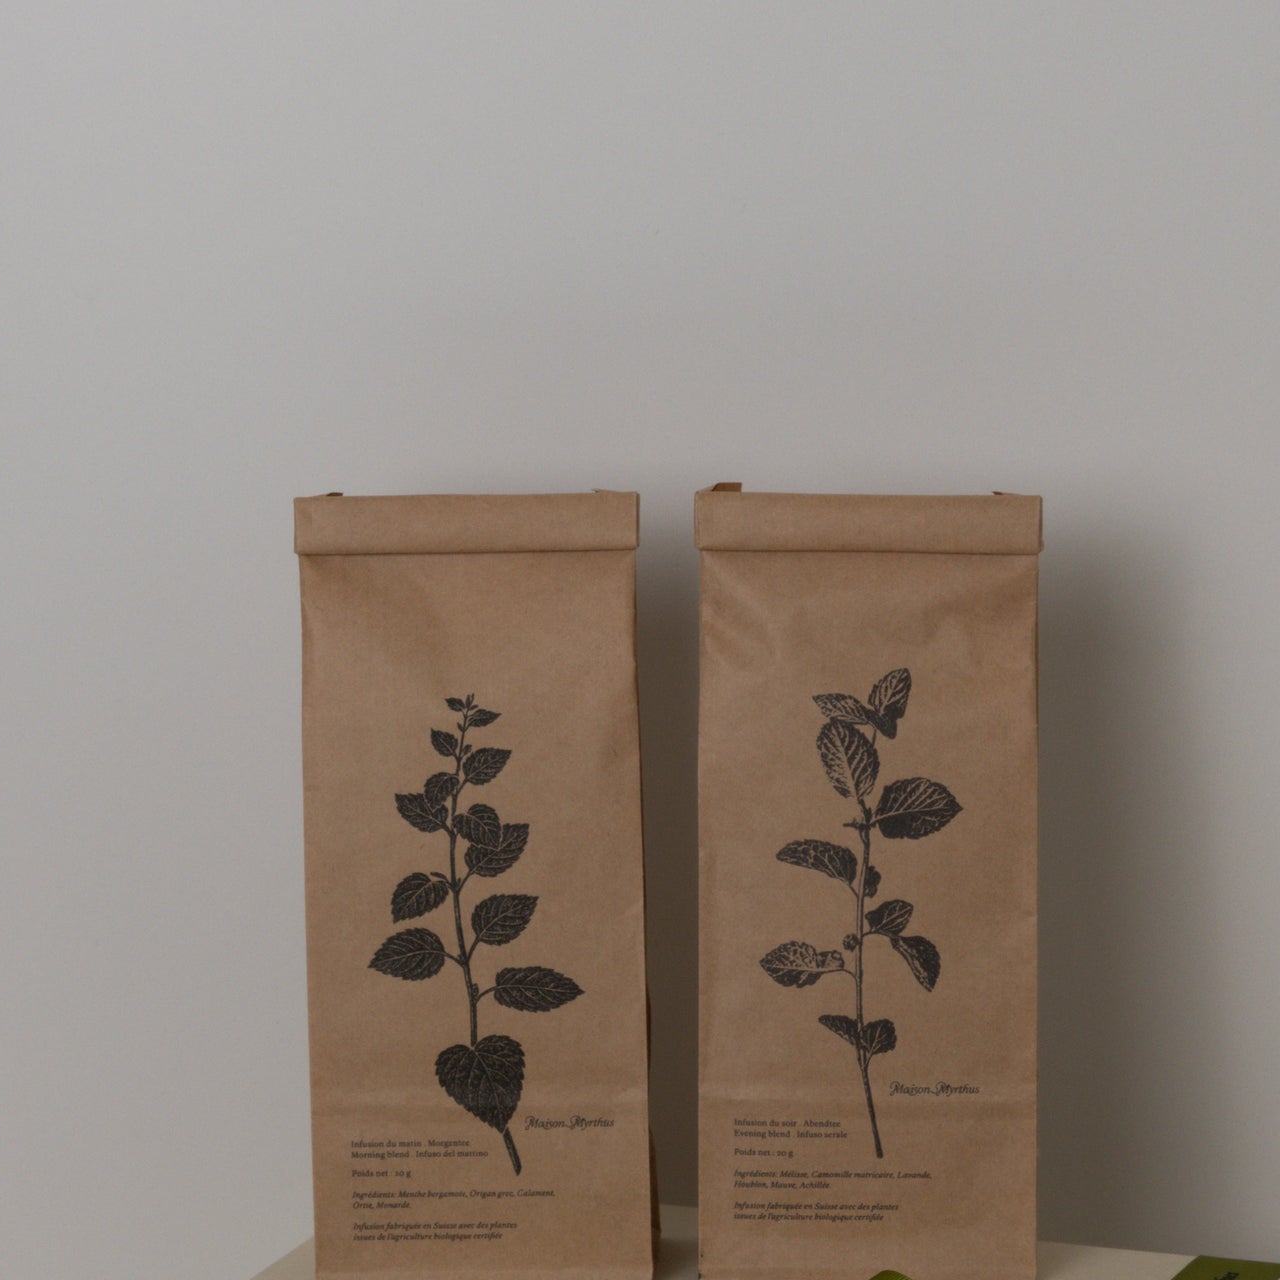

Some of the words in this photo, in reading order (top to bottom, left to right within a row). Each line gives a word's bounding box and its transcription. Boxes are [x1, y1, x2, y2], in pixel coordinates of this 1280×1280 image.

[890, 1081, 933, 1096] Maison
[934, 1081, 980, 1097] Myrthus
[525, 1115, 566, 1130] Maison
[567, 1115, 614, 1130] Myrthus
[734, 1119, 767, 1128] Infusion
[769, 1119, 780, 1128] du
[781, 1119, 797, 1128] soir
[803, 1119, 841, 1128] Abendtee
[734, 1130, 766, 1139] Evening
[768, 1129, 790, 1138] blend
[797, 1129, 822, 1138] Infuso
[823, 1129, 849, 1138] serale
[351, 1139, 384, 1148] Infusion
[386, 1139, 396, 1148] du
[398, 1139, 422, 1148] matin
[428, 1138, 469, 1149] Morgentee
[351, 1150, 385, 1160] Morning
[387, 1150, 409, 1158] blend
[416, 1149, 441, 1158] Infuso
[443, 1149, 455, 1157] del
[734, 1148, 756, 1156] Poids
[351, 1169, 373, 1178] Poids
[734, 1202, 766, 1210] Infusion
[814, 1202, 838, 1210] Suisse
[858, 1202, 870, 1210] des
[870, 1202, 899, 1211] plantes
[757, 1212, 766, 1220] de
[353, 1222, 384, 1231] Infusion
[433, 1222, 457, 1230] Suisse
[476, 1222, 488, 1230] des
[488, 1222, 518, 1231] plantes
[377, 1233, 386, 1241] de
